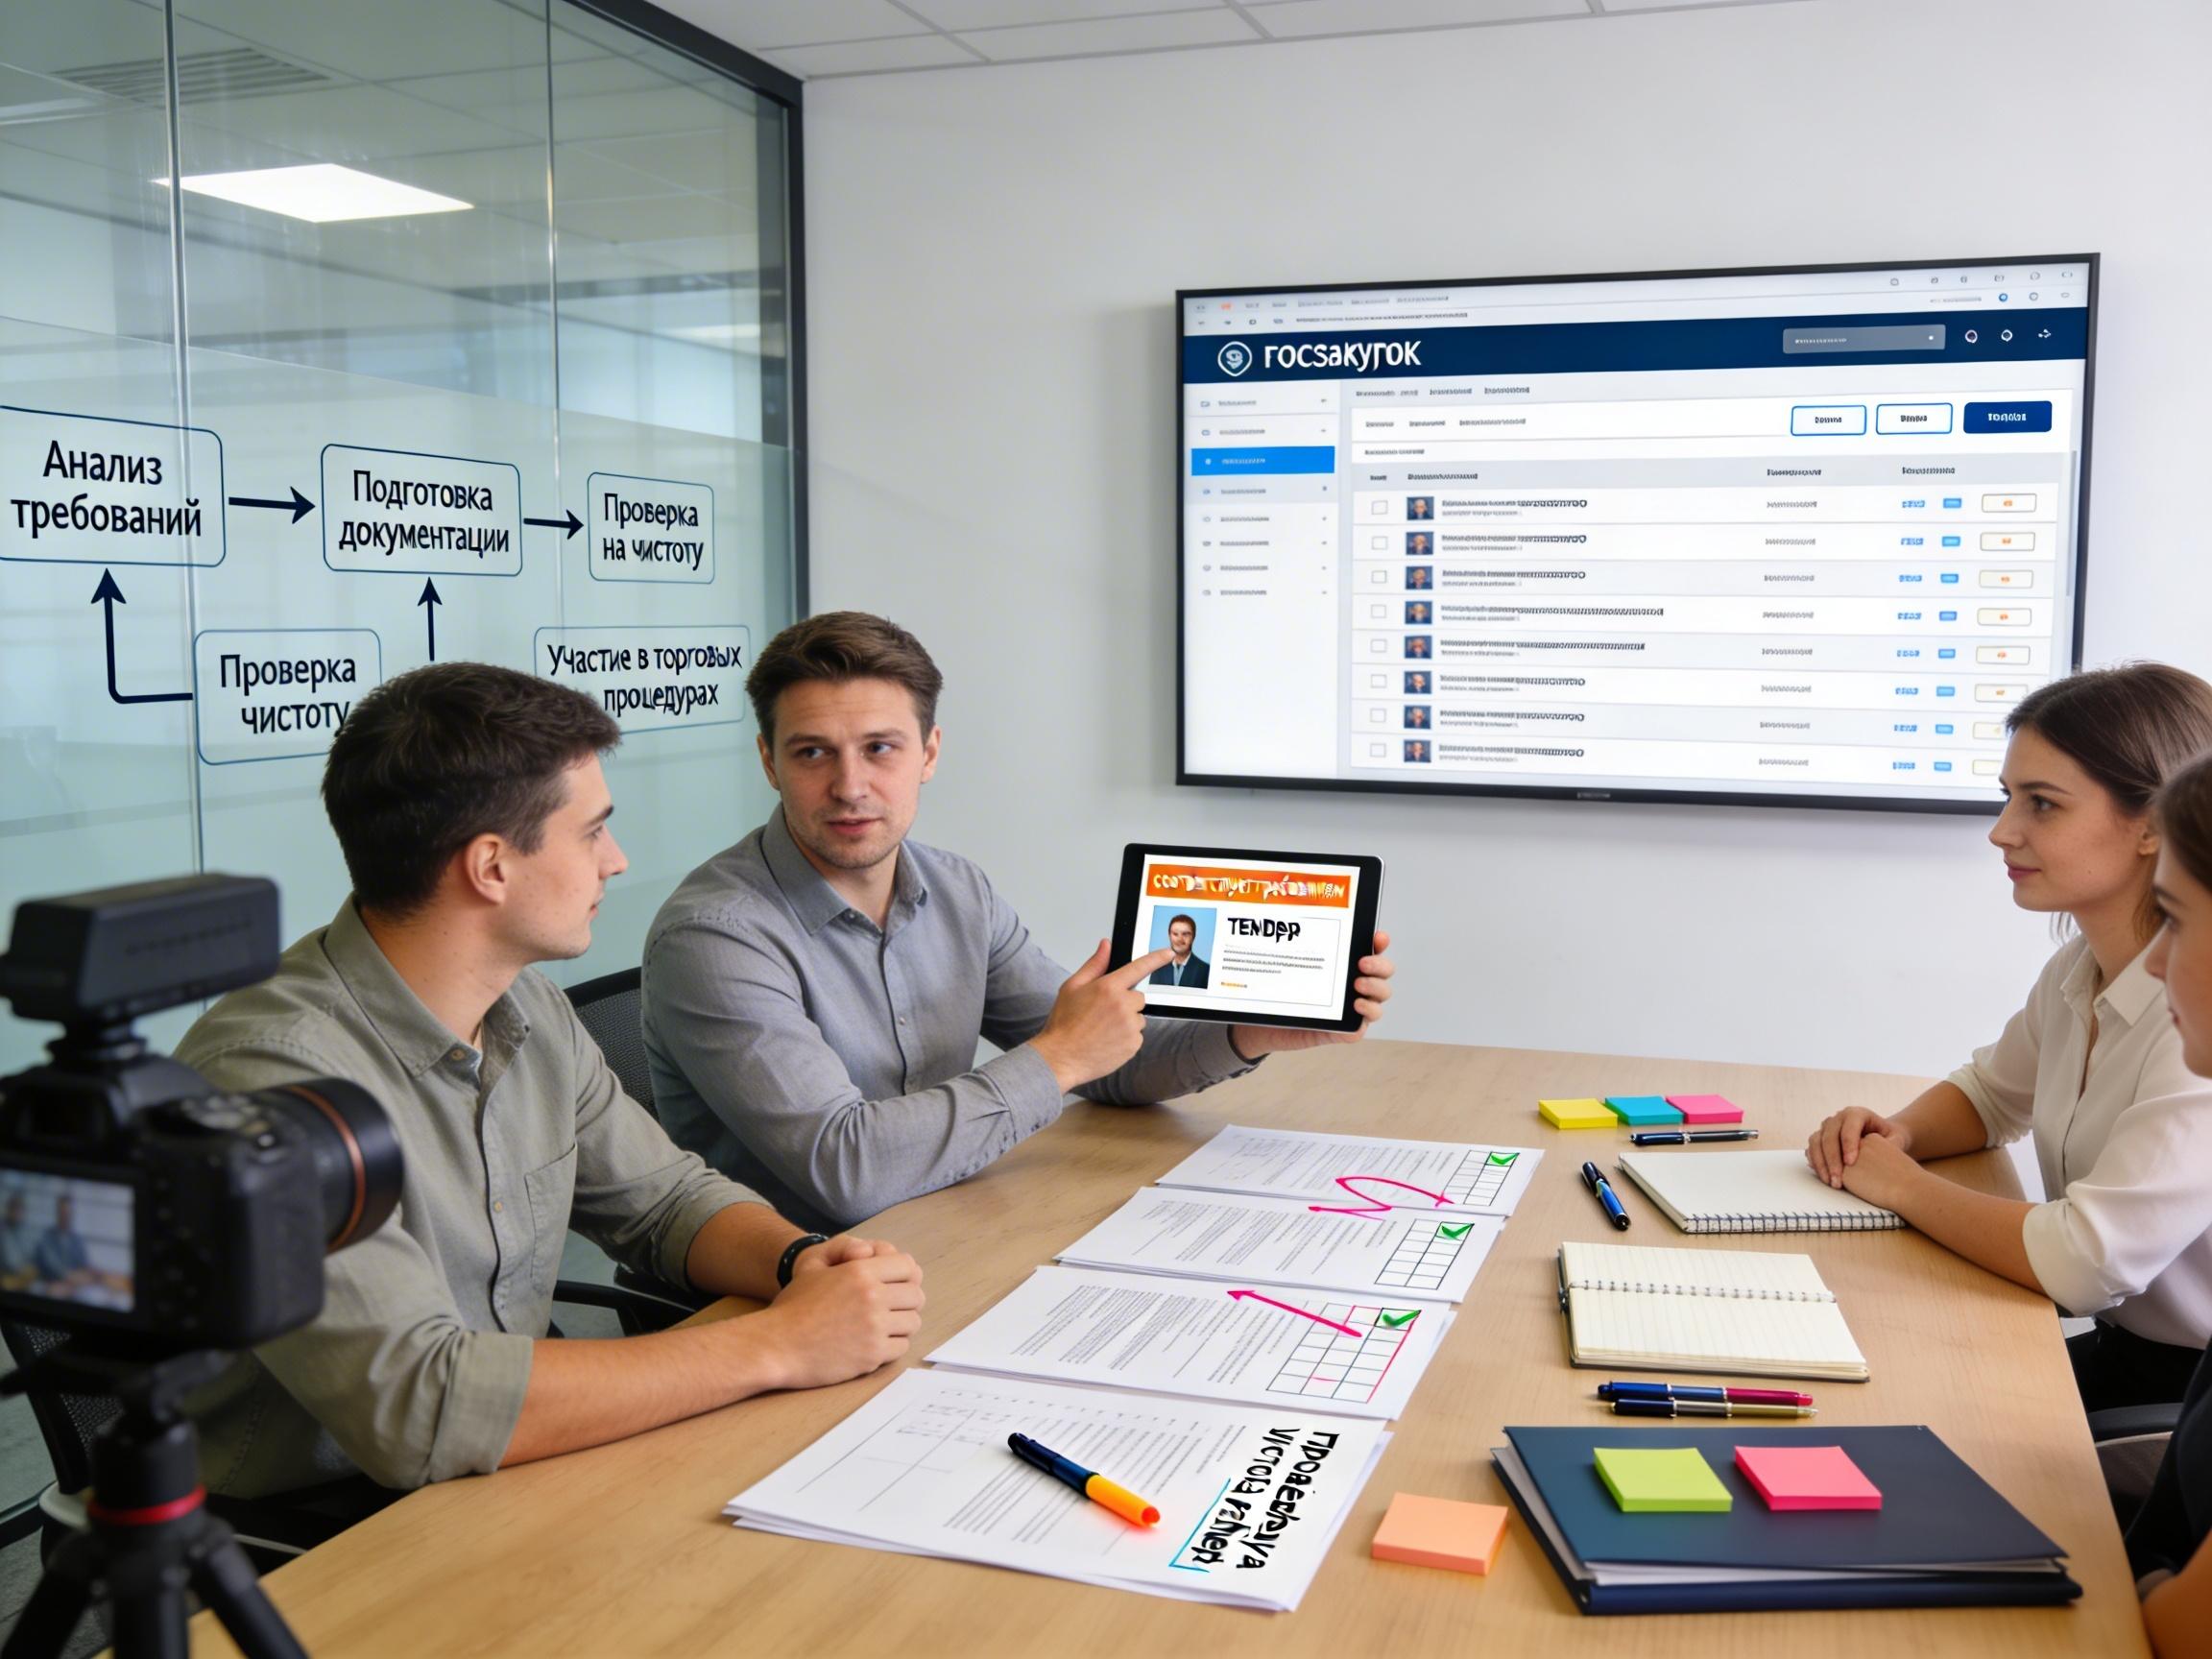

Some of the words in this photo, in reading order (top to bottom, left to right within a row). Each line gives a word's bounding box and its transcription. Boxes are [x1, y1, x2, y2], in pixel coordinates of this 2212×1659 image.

[43, 440, 162, 485] Анализ
[353, 469, 493, 511] Подготовка
[11, 493, 201, 539] требований
[604, 493, 699, 531] Проверка
[339, 520, 510, 559] документации
[603, 538, 626, 561] на
[632, 539, 704, 571] чистоту
[220, 654, 356, 696] Проверка
[547, 644, 632, 675] Участие
[637, 648, 648, 669] в
[654, 645, 742, 675] торговых
[241, 701, 350, 737] чистоту
[604, 684, 719, 717] процедурах
